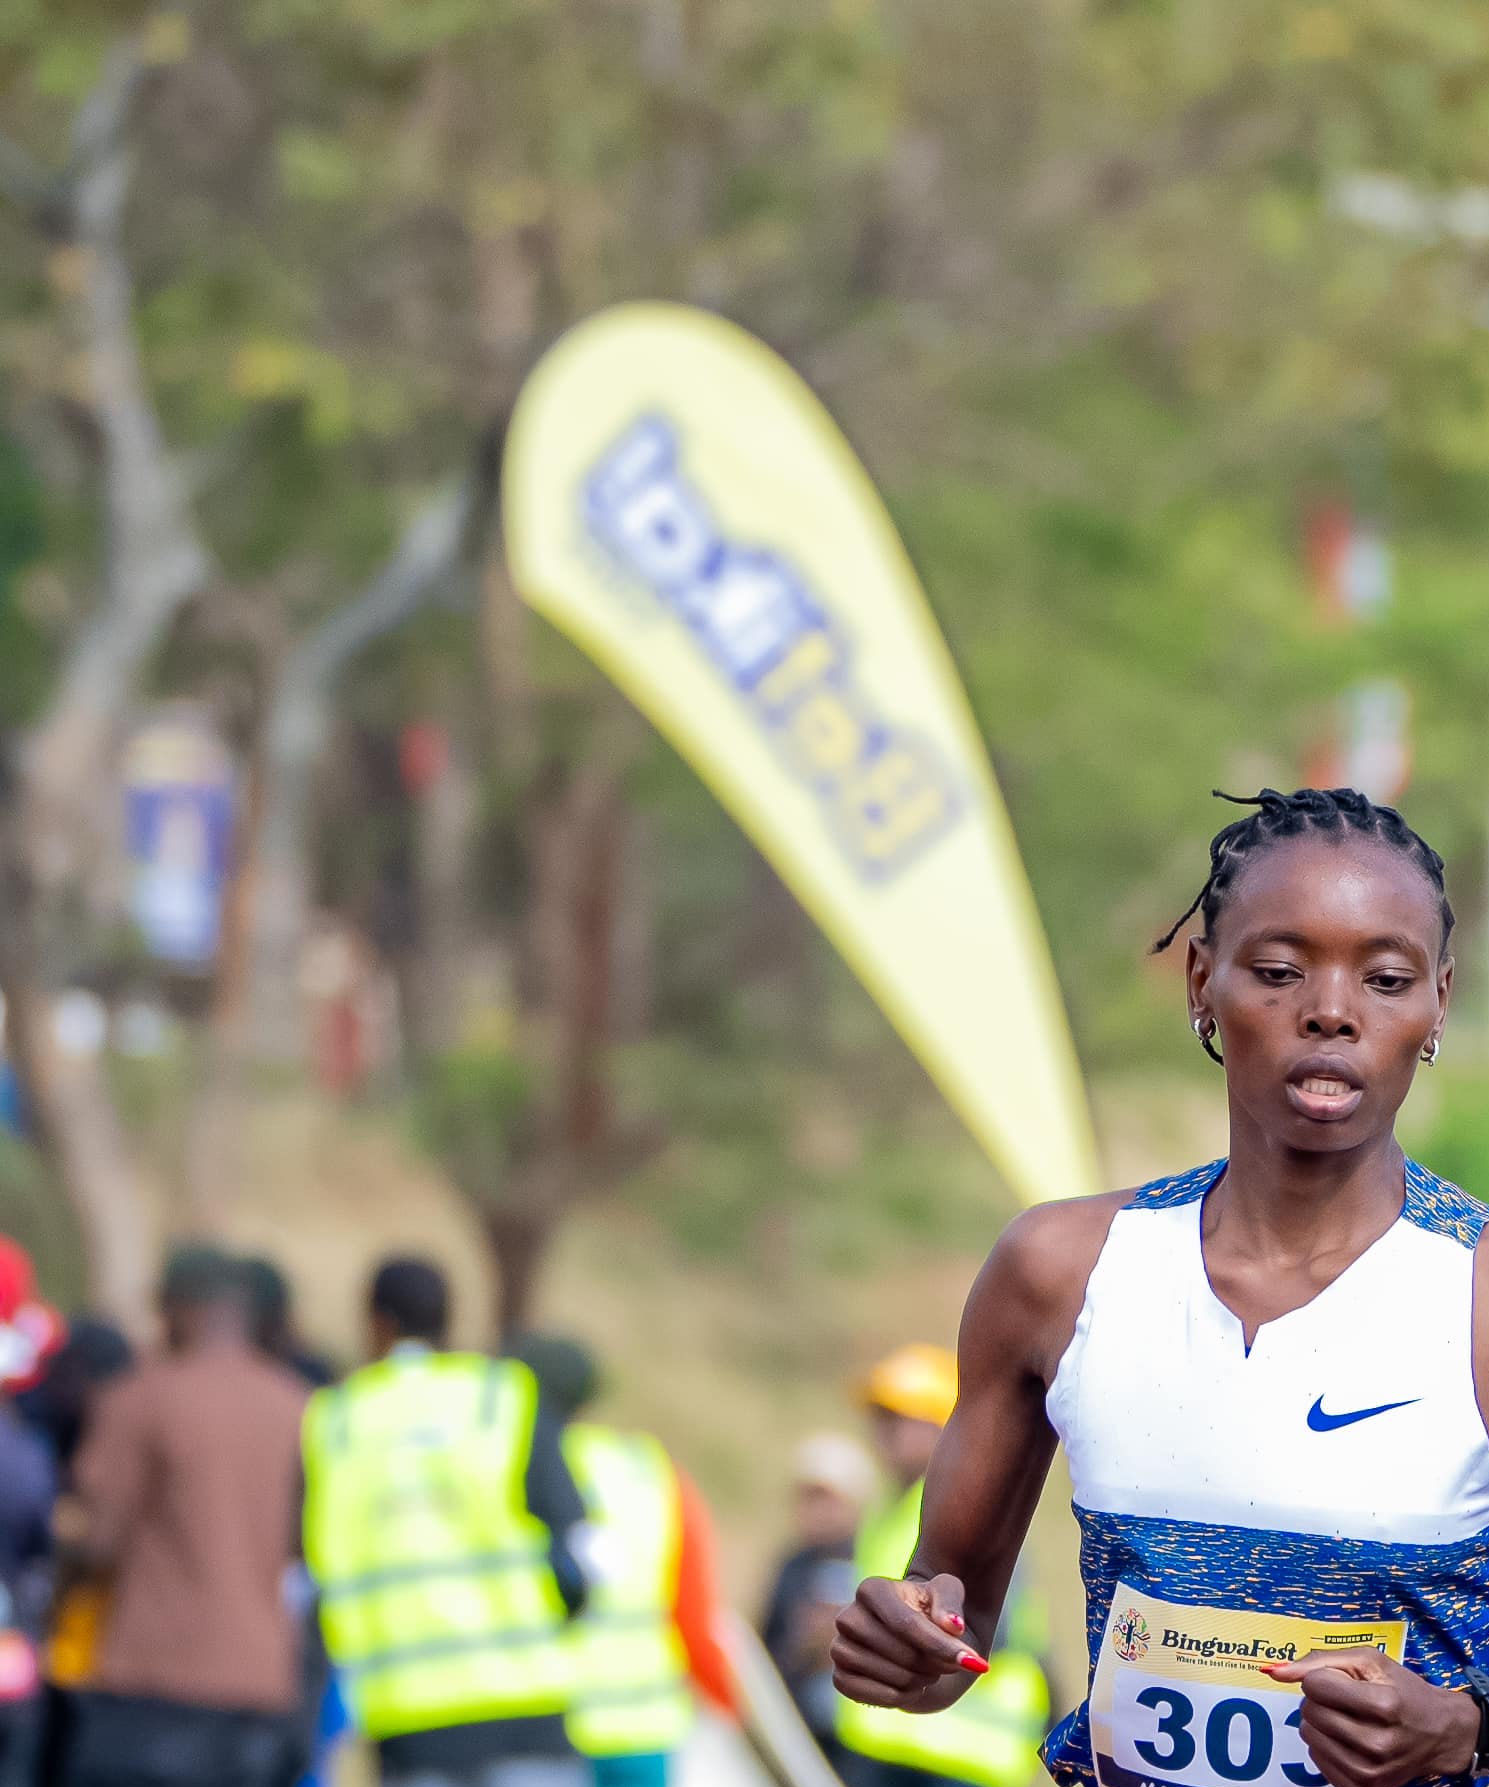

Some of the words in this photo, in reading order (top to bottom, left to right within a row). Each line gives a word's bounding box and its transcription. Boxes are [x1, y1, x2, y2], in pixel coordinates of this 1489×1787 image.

[1161, 1628, 1297, 1661] BingwaFest
[1326, 1636, 1360, 1644] POWERED
[1362, 1634, 1372, 1642] BY
[1176, 1655, 1196, 1665] Where
[1197, 1658, 1208, 1666] the
[1210, 1660, 1224, 1668] best
[1224, 1661, 1238, 1669] rise
